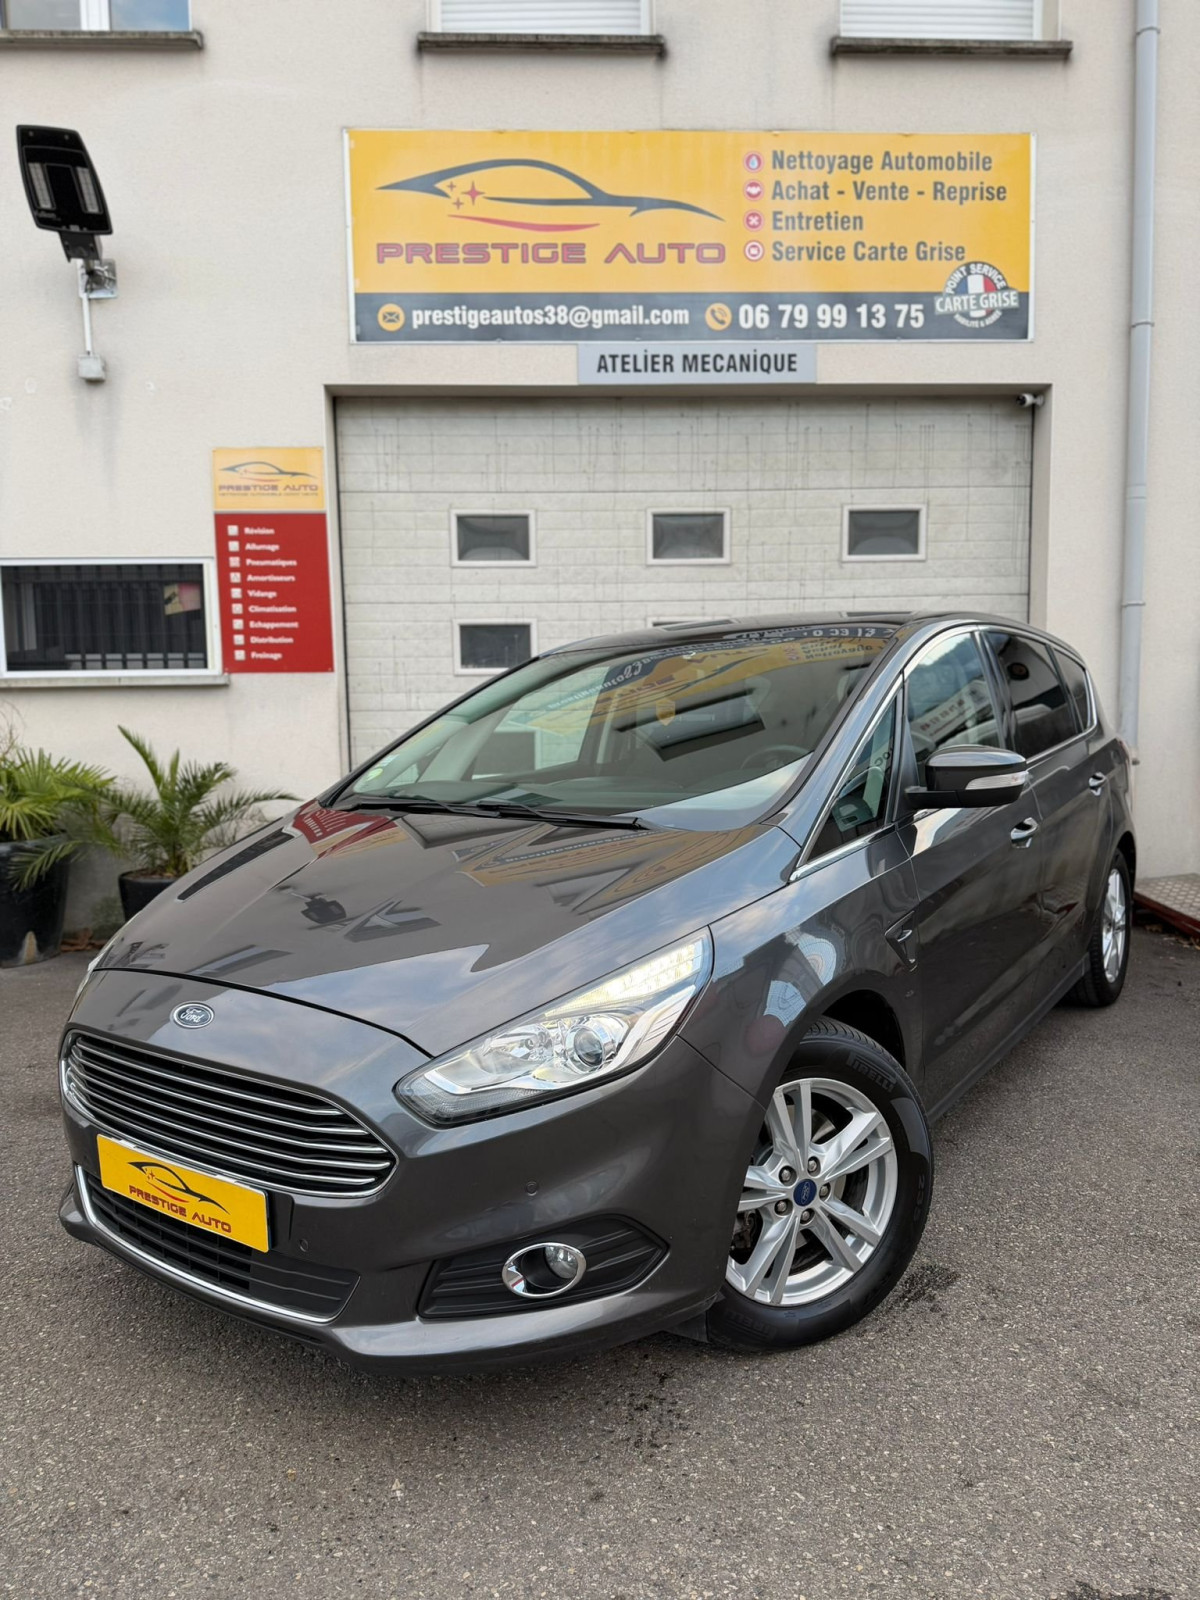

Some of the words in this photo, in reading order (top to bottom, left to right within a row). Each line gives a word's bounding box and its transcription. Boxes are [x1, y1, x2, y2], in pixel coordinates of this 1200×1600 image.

[771, 150, 873, 174] Nettoyage
[881, 151, 993, 171] Automobile
[771, 180, 830, 201] Achat
[853, 181, 909, 201] Vente
[932, 182, 1008, 205] Reprise
[772, 211, 864, 231] Entretien
[376, 243, 586, 264] PRESTIGE
[604, 243, 726, 264] AUTO
[772, 241, 846, 262] Service
[853, 241, 909, 262] Carte
[915, 242, 966, 262] Grise
[945, 266, 968, 295] POINT
[969, 263, 1007, 290] SERVICE
[935, 295, 978, 313] CARTE
[979, 291, 1019, 310] GRISE
[412, 305, 690, 330] prestigeautos38@gmail.com
[738, 304, 770, 329] 06
[778, 304, 809, 329] 79
[816, 304, 848, 329] 99
[856, 304, 886, 328] 13
[894, 304, 925, 328] 75
[180, 1007, 205, 1023] Ford
[846, 1052, 897, 1093] PIRELLI
[129, 1184, 187, 1218] PRESTIGE
[191, 1213, 232, 1234] AUTO
